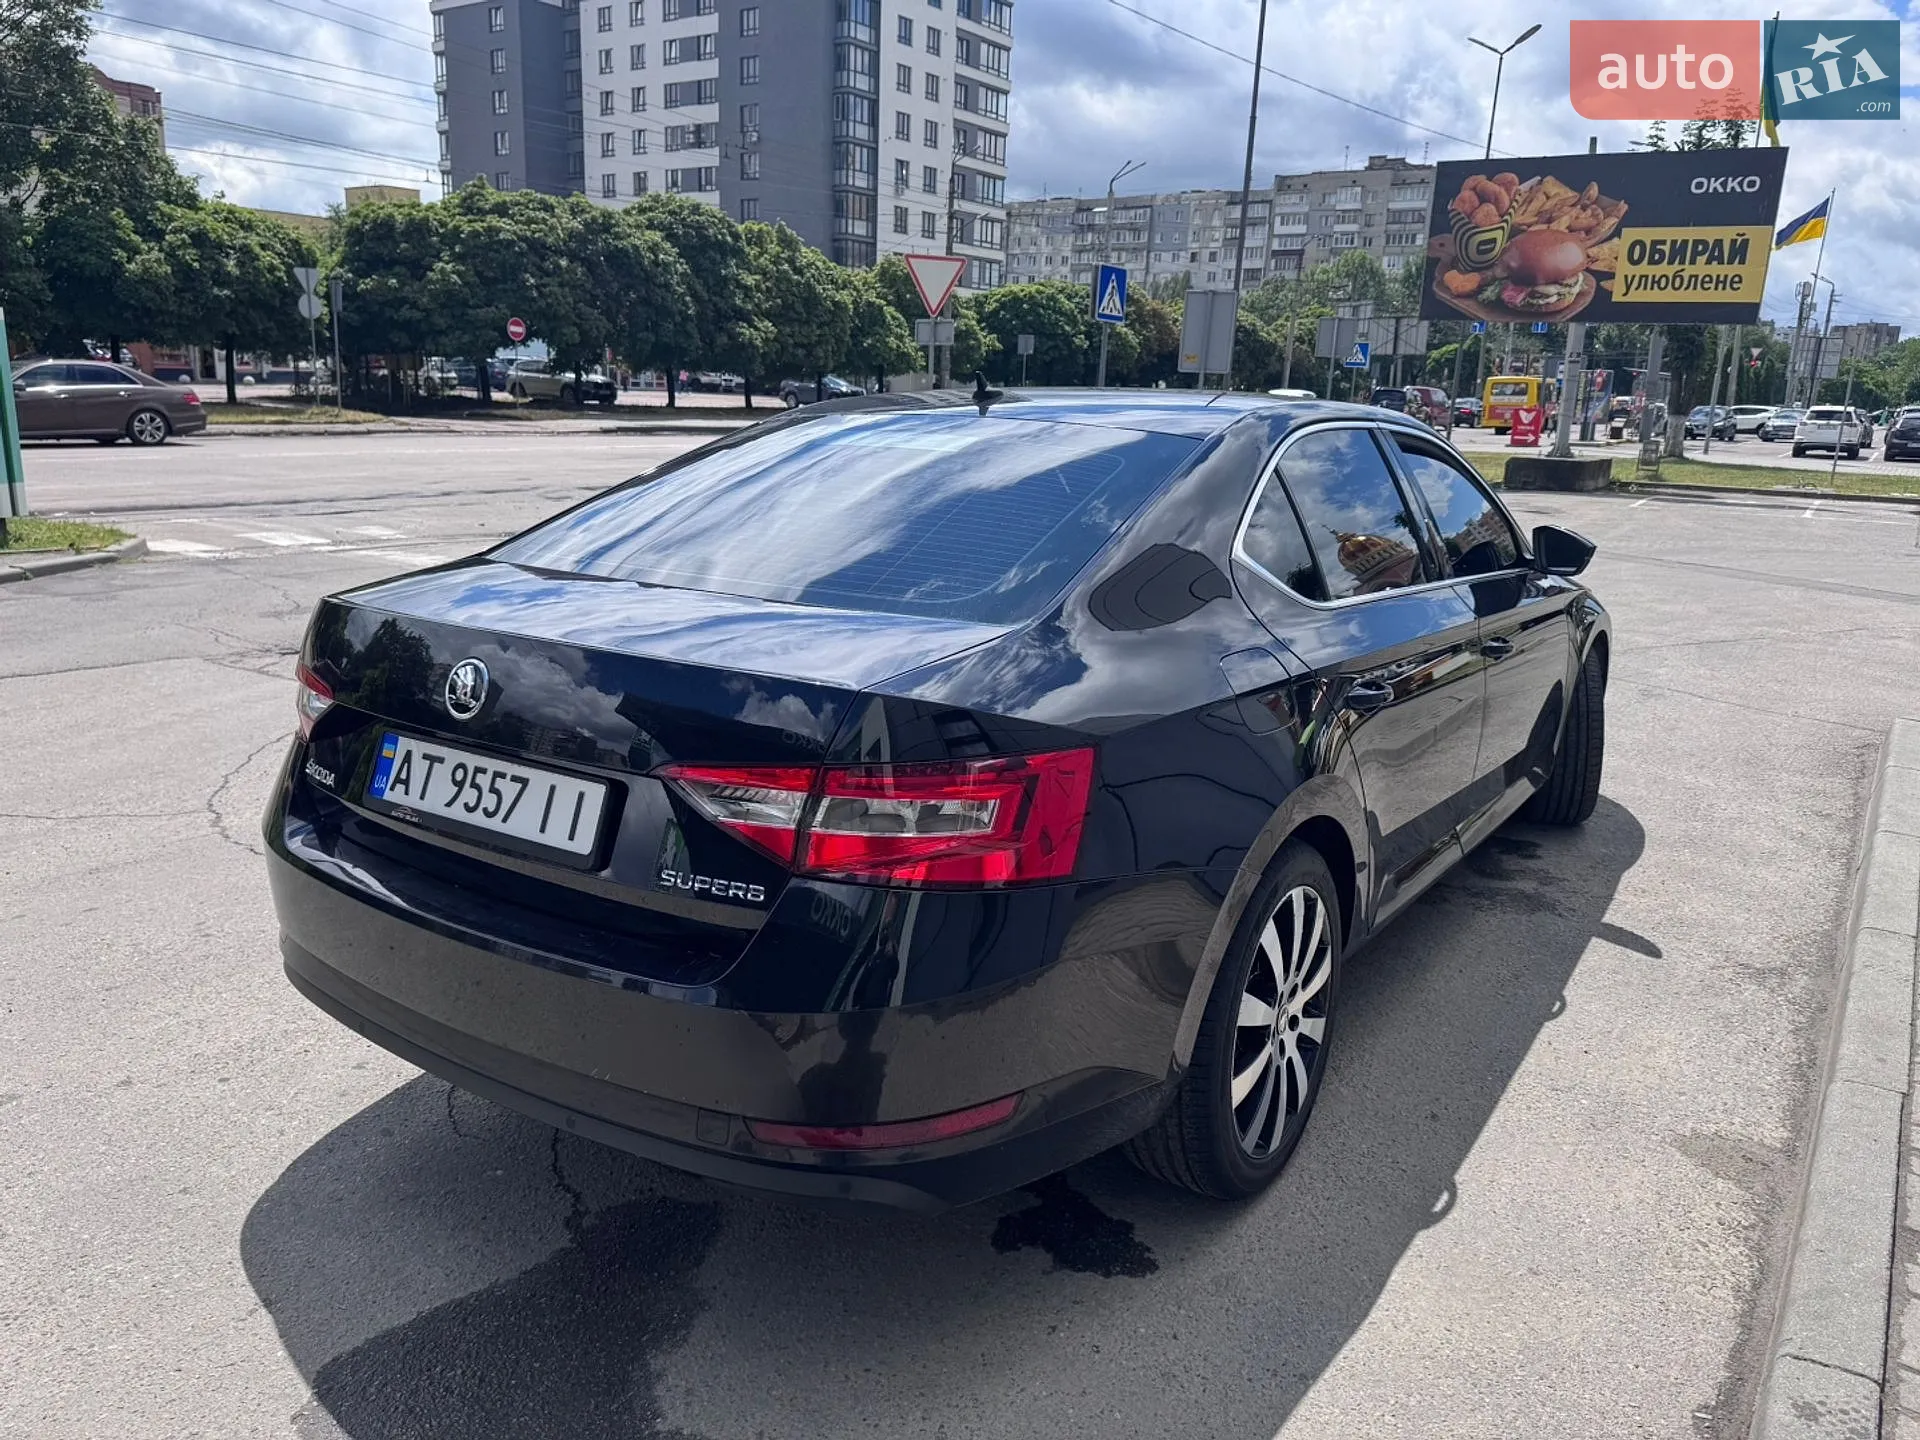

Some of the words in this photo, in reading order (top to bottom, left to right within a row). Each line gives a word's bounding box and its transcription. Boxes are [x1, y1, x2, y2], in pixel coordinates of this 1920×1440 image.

[1690, 176, 1761, 194] OKKO
[1626, 232, 1751, 267] ОБИРАЙ
[1622, 268, 1744, 297] улюблене
[374, 774, 388, 790] UA
[389, 749, 446, 801] AT
[443, 762, 530, 824] 9557
[660, 869, 765, 902] SUPERB
